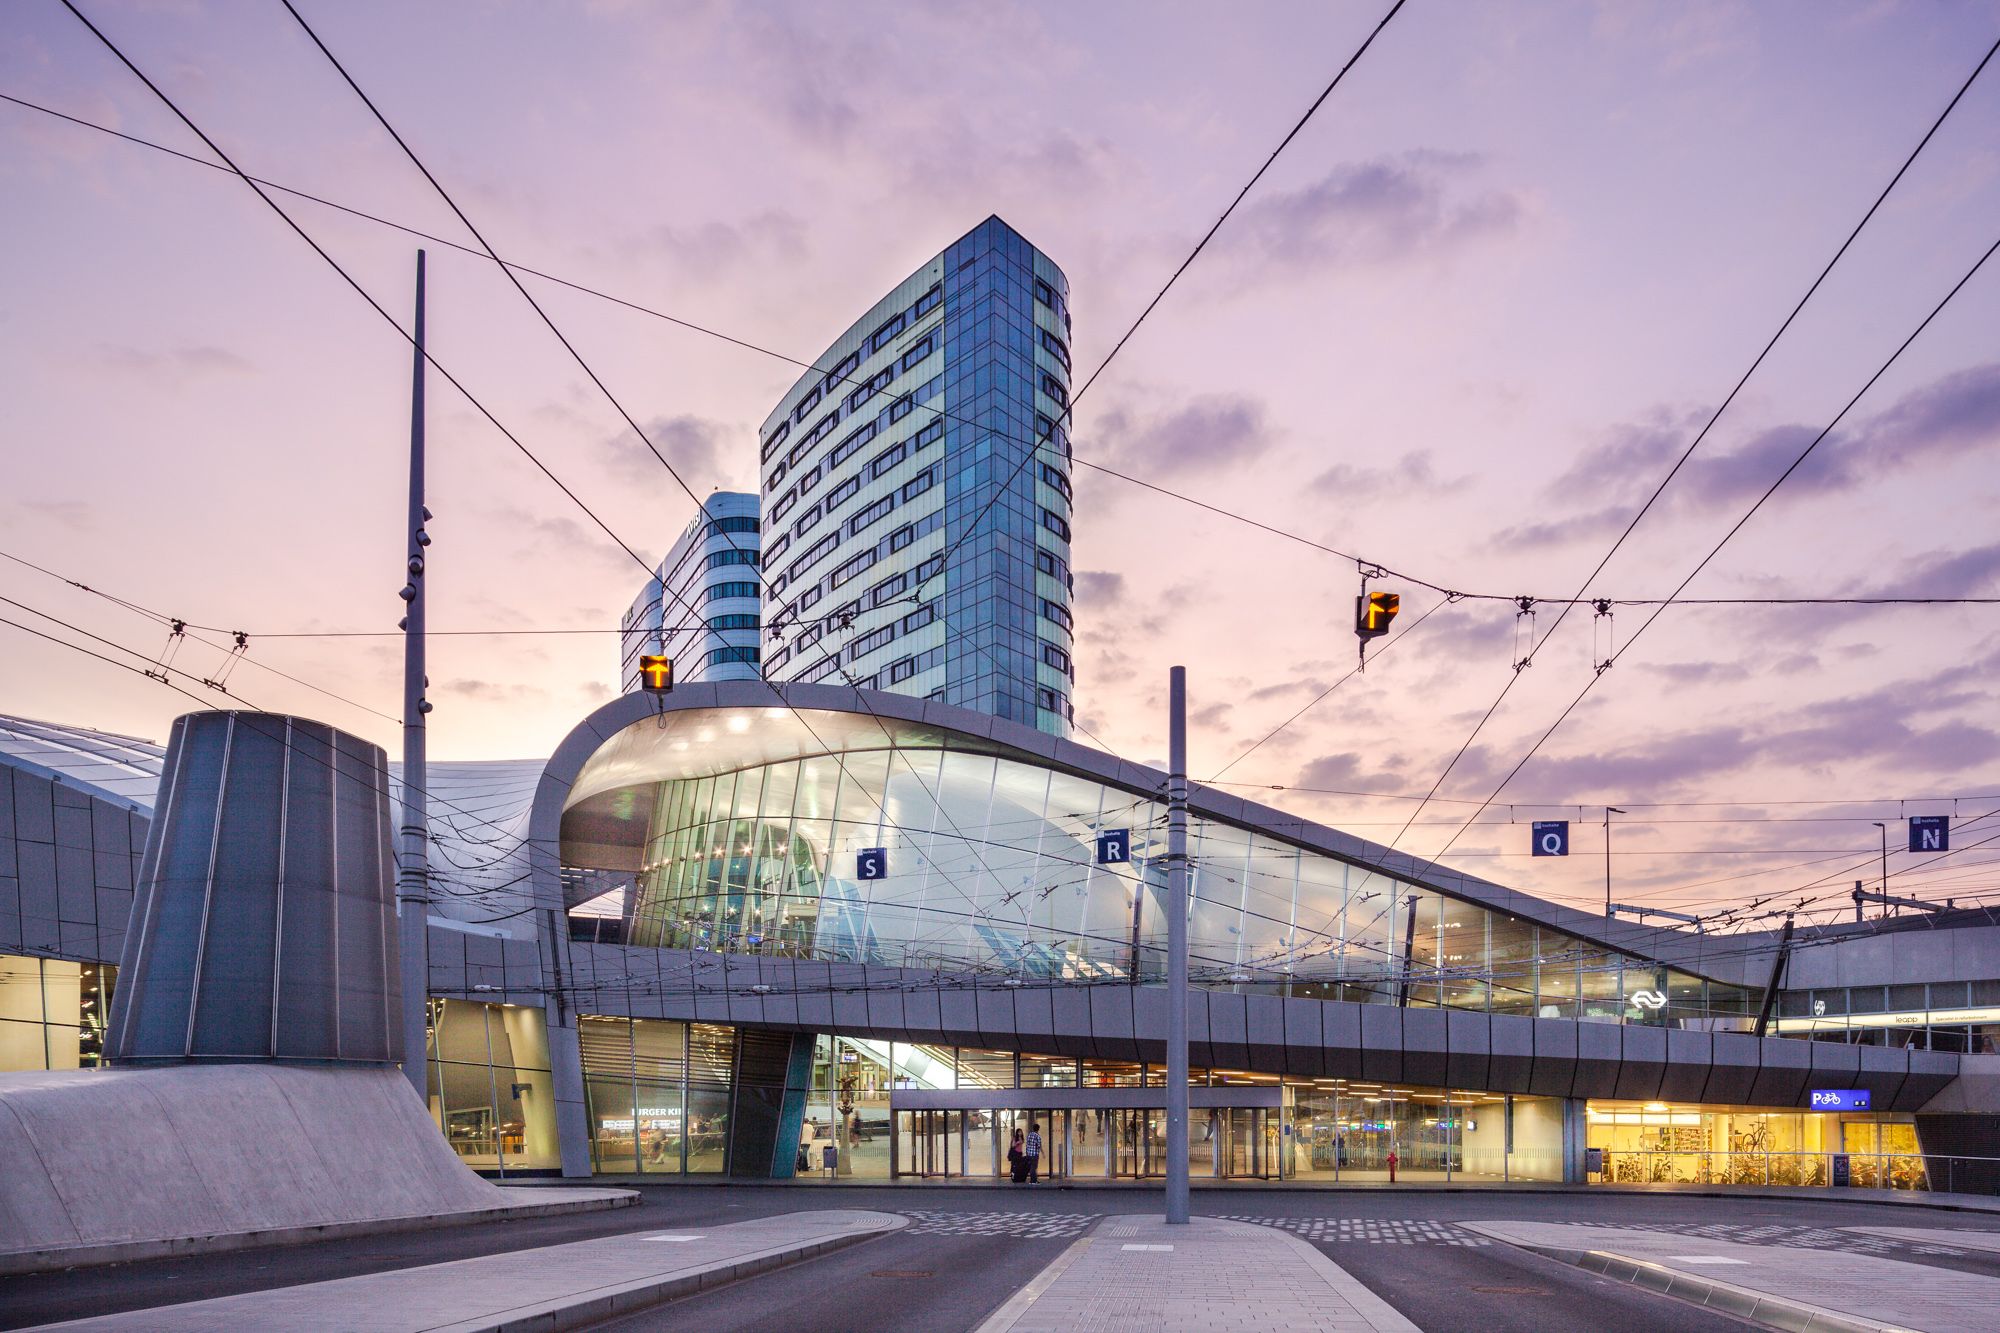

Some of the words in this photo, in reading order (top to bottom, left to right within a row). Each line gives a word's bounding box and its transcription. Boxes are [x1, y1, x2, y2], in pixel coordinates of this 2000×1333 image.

[1542, 833, 1561, 856] Q
[1923, 829, 1940, 849] N
[1107, 841, 1121, 861] R
[865, 859, 877, 877] S
[1896, 1016, 1919, 1024] leapp
[1812, 1093, 1822, 1105] P
[667, 1108, 690, 1116] KI
